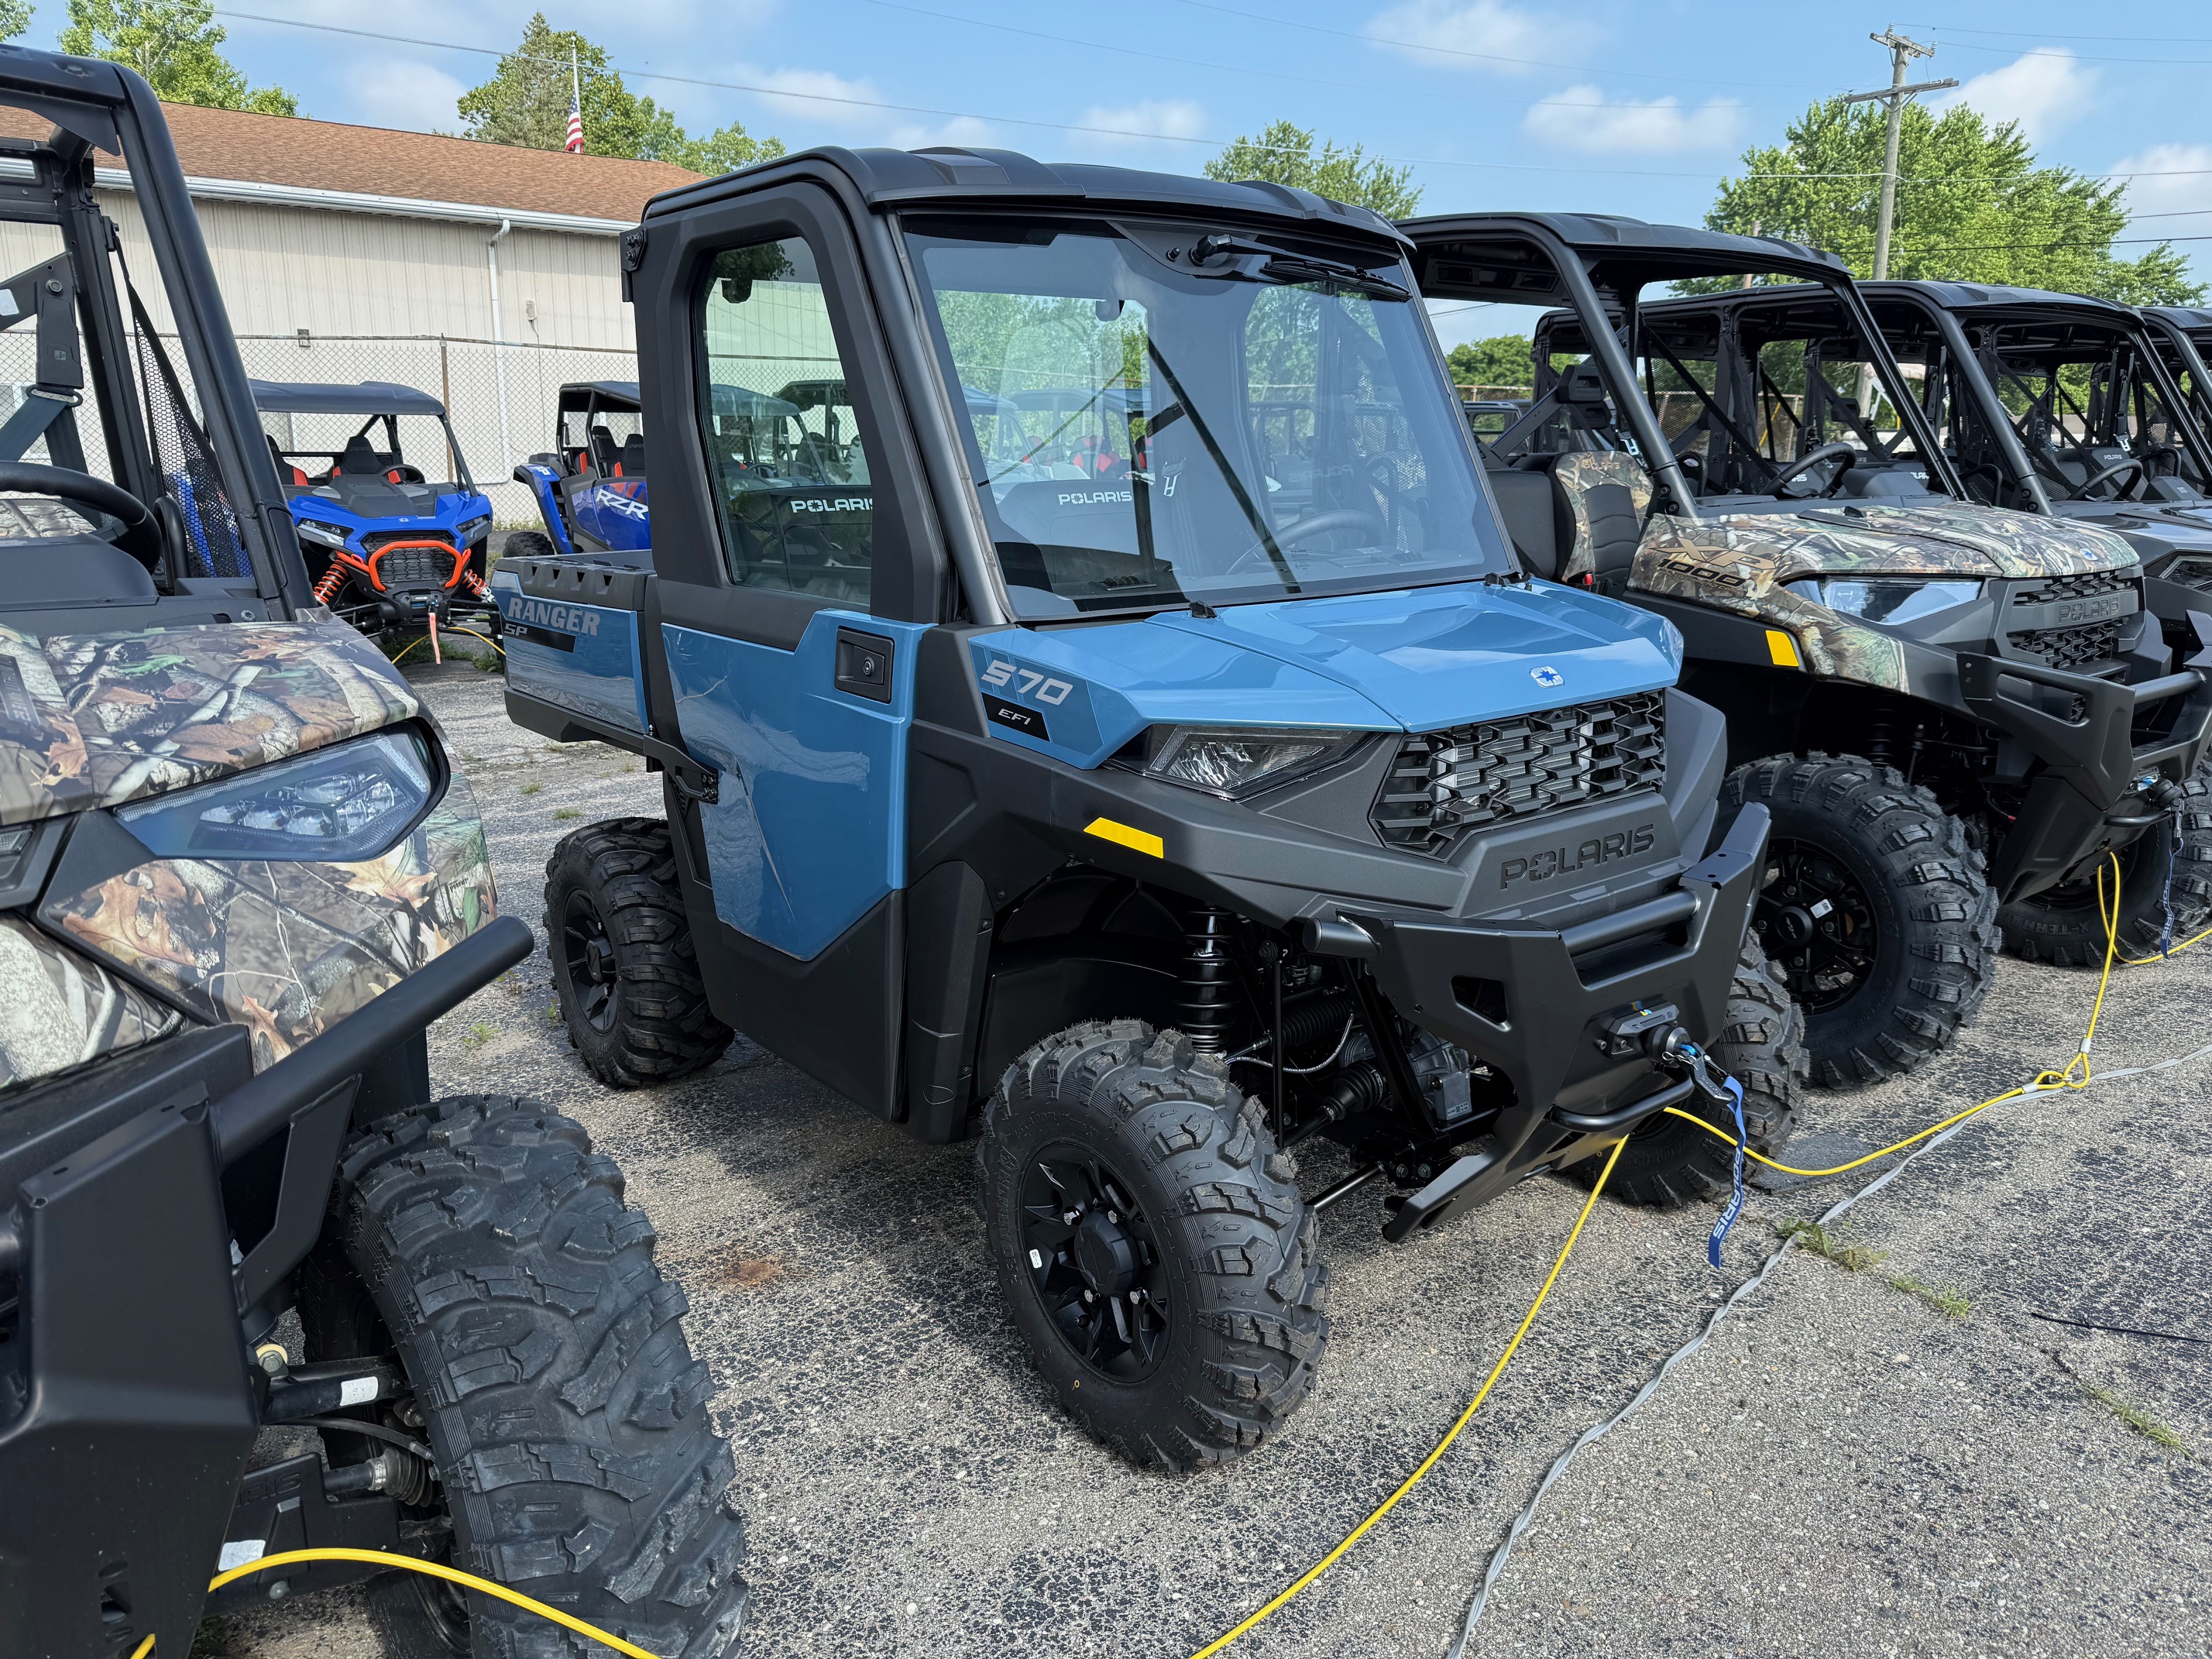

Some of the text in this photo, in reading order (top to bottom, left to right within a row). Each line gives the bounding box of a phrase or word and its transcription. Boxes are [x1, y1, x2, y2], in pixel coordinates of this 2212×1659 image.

[596, 488, 649, 520] RZR
[1058, 491, 1132, 505] POLARIS
[1647, 536, 1781, 571] XP
[1657, 558, 1747, 588] 1000
[508, 597, 600, 636] RANGER
[2058, 597, 2119, 624] POLARIS
[503, 623, 528, 637] SP
[981, 659, 1073, 706] 570
[998, 709, 1032, 726] EFI
[1500, 823, 1655, 891] POLARIS
[1712, 1147, 1742, 1239] POLARIS
